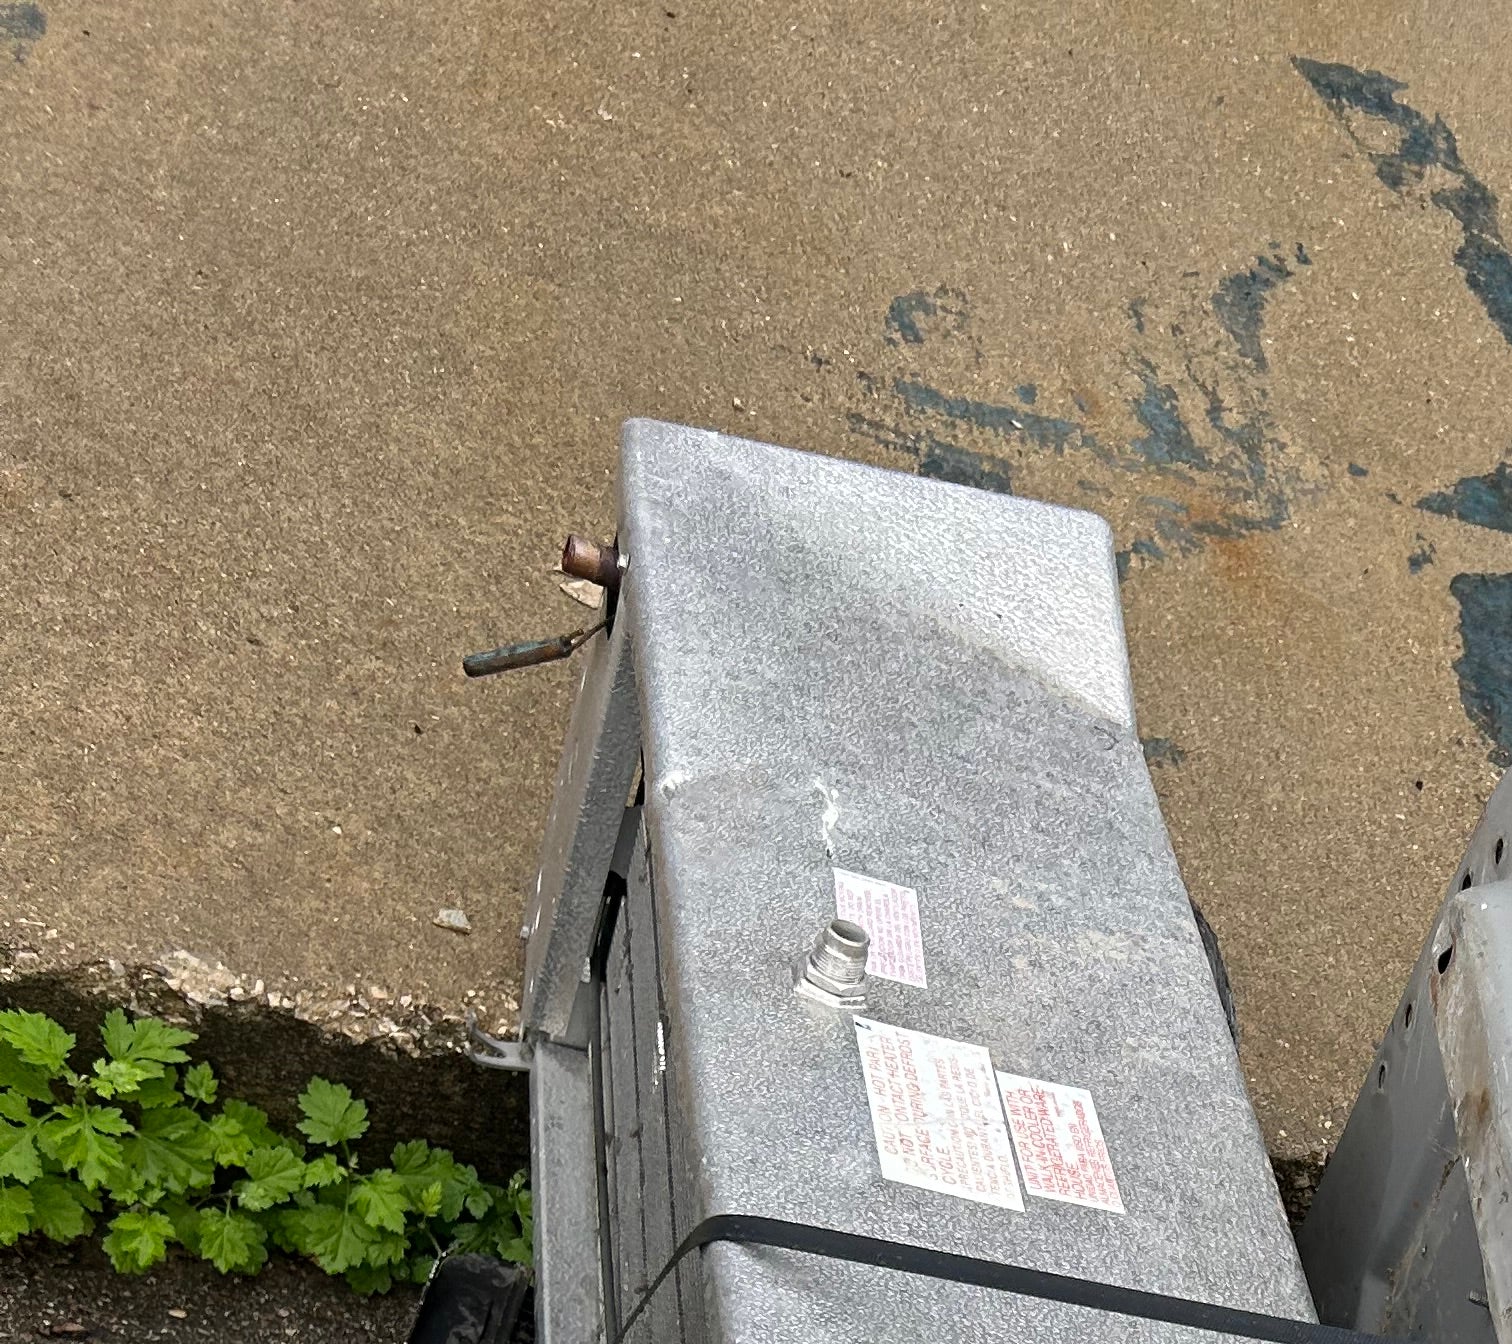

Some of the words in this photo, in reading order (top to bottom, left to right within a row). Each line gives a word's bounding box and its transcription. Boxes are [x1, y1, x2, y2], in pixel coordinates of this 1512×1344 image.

[879, 1036, 898, 1077] HEATER
[895, 1031, 917, 1080] DEFROST
[870, 1073, 885, 1096] HOT
[1011, 1118, 1028, 1139] USE
[898, 1131, 914, 1155] NOT
